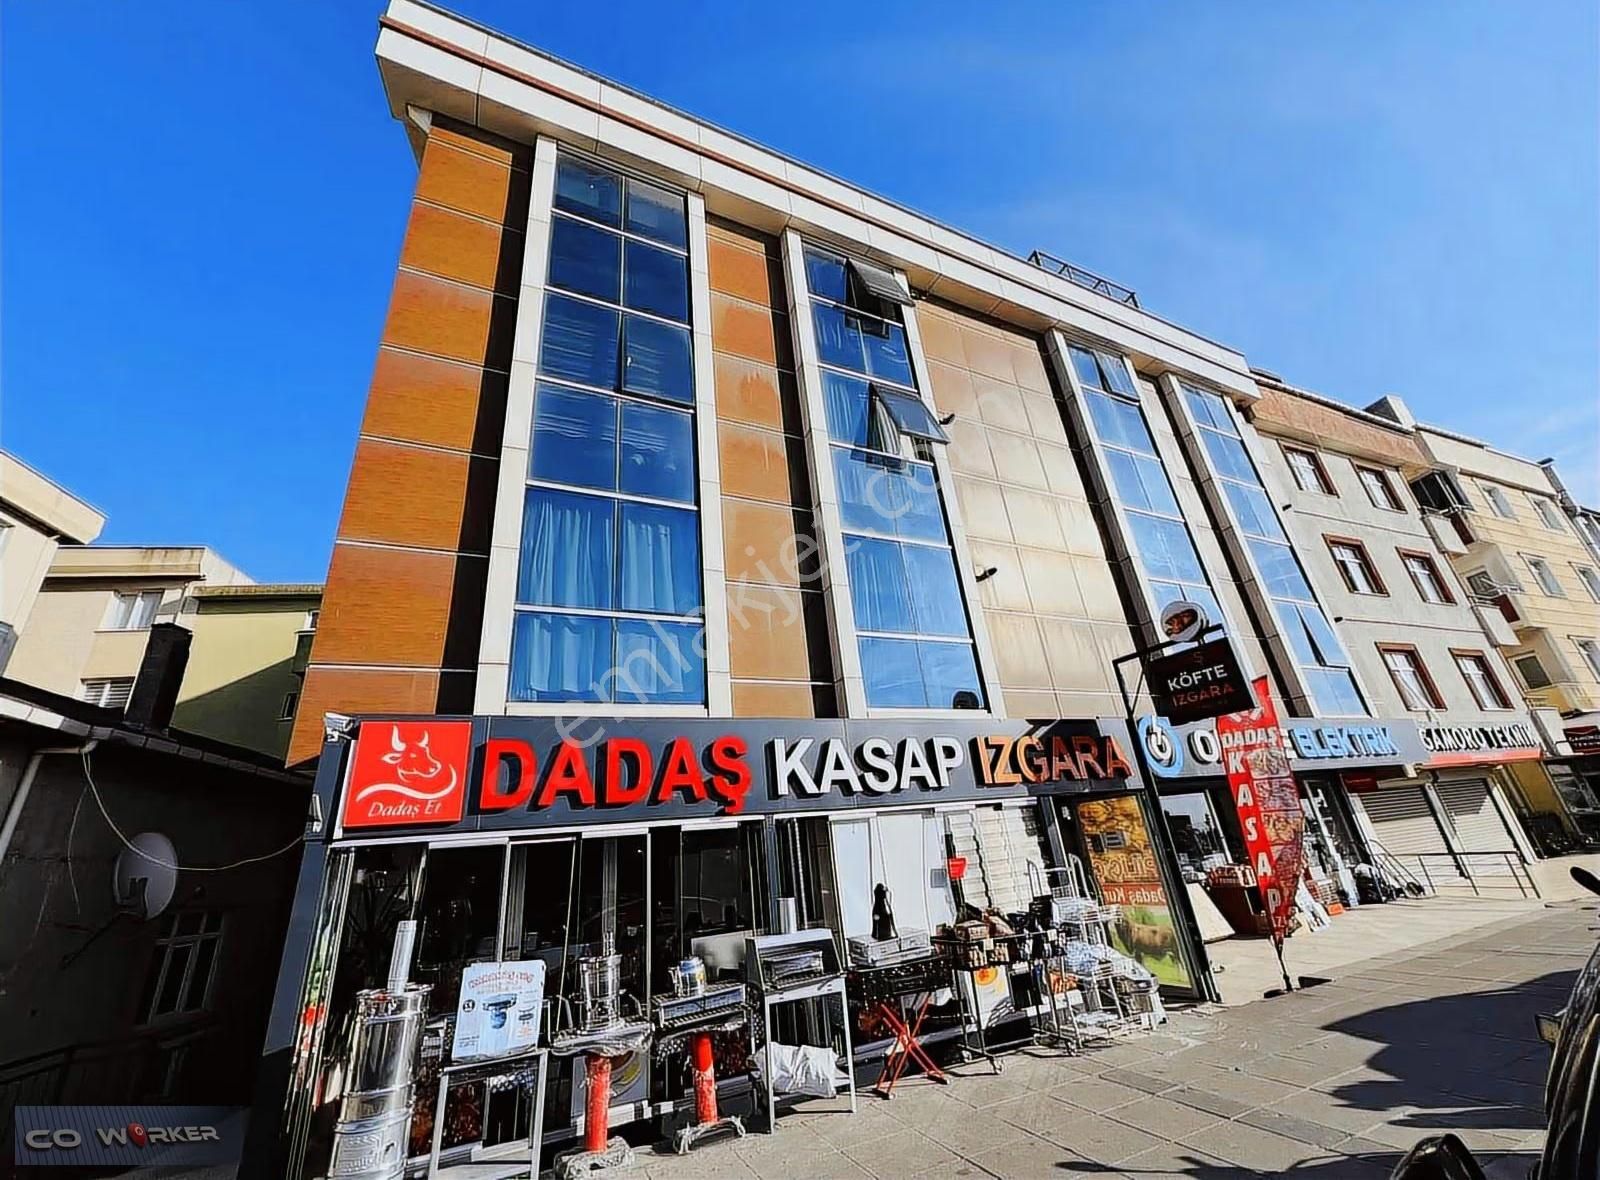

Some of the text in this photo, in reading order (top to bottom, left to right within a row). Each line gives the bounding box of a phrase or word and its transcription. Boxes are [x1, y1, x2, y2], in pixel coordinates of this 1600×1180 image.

[1167, 664, 1228, 691] KÖFTE
[1172, 684, 1234, 707] IZGARA
[480, 735, 1135, 814] DADAŞ KASAP IZGARA
[367, 799, 442, 818] Dadaş Et
[1227, 750, 1283, 914] KASAP
